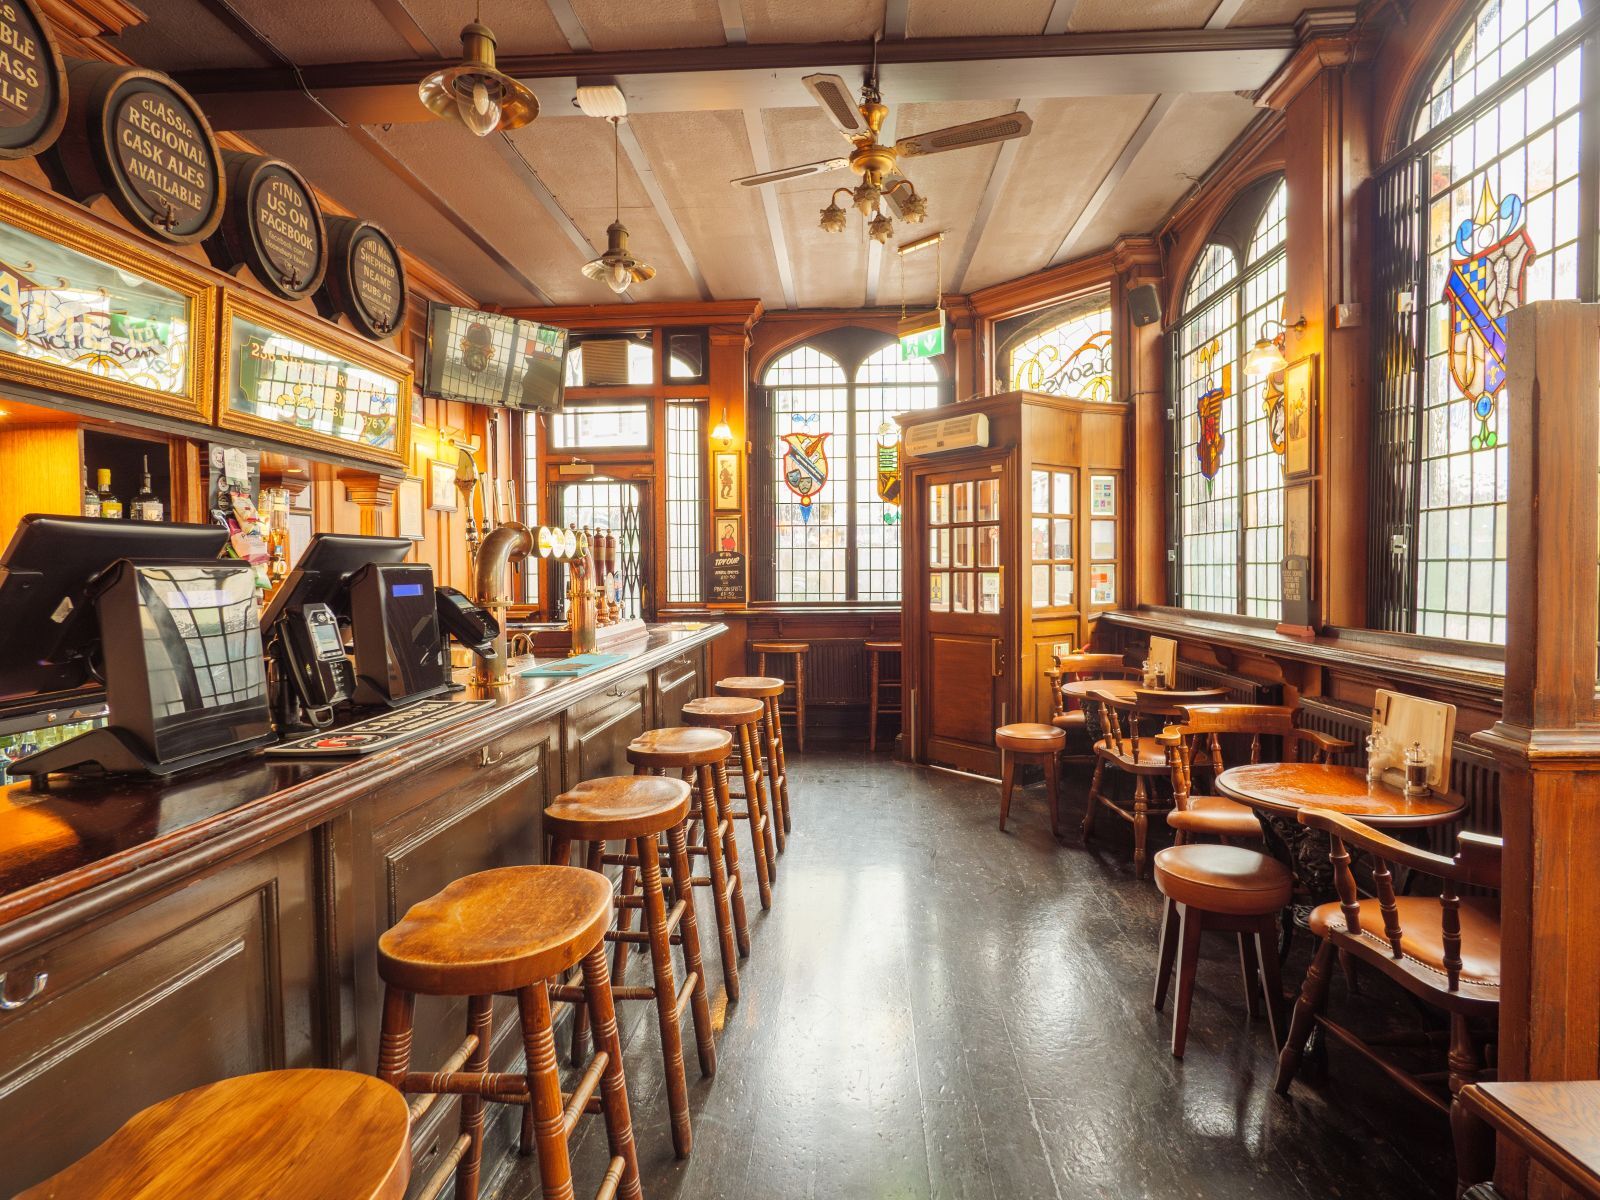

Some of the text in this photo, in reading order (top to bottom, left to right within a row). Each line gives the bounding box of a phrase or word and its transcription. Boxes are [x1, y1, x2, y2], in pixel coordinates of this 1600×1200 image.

[0, 4, 16, 22] S
[129, 106, 206, 168] REGIONAL
[142, 99, 192, 138] CLASSIC
[123, 128, 205, 189] CASK ALES
[128, 157, 202, 210] AVAILABLE
[273, 182, 302, 207] FIND
[261, 208, 313, 251] FACEBOOK
[267, 192, 308, 231] US ON
[360, 247, 395, 279] SHEPHERD
[363, 265, 392, 291] NEAME
[362, 281, 382, 298] PUBS
[383, 293, 392, 304] AT
